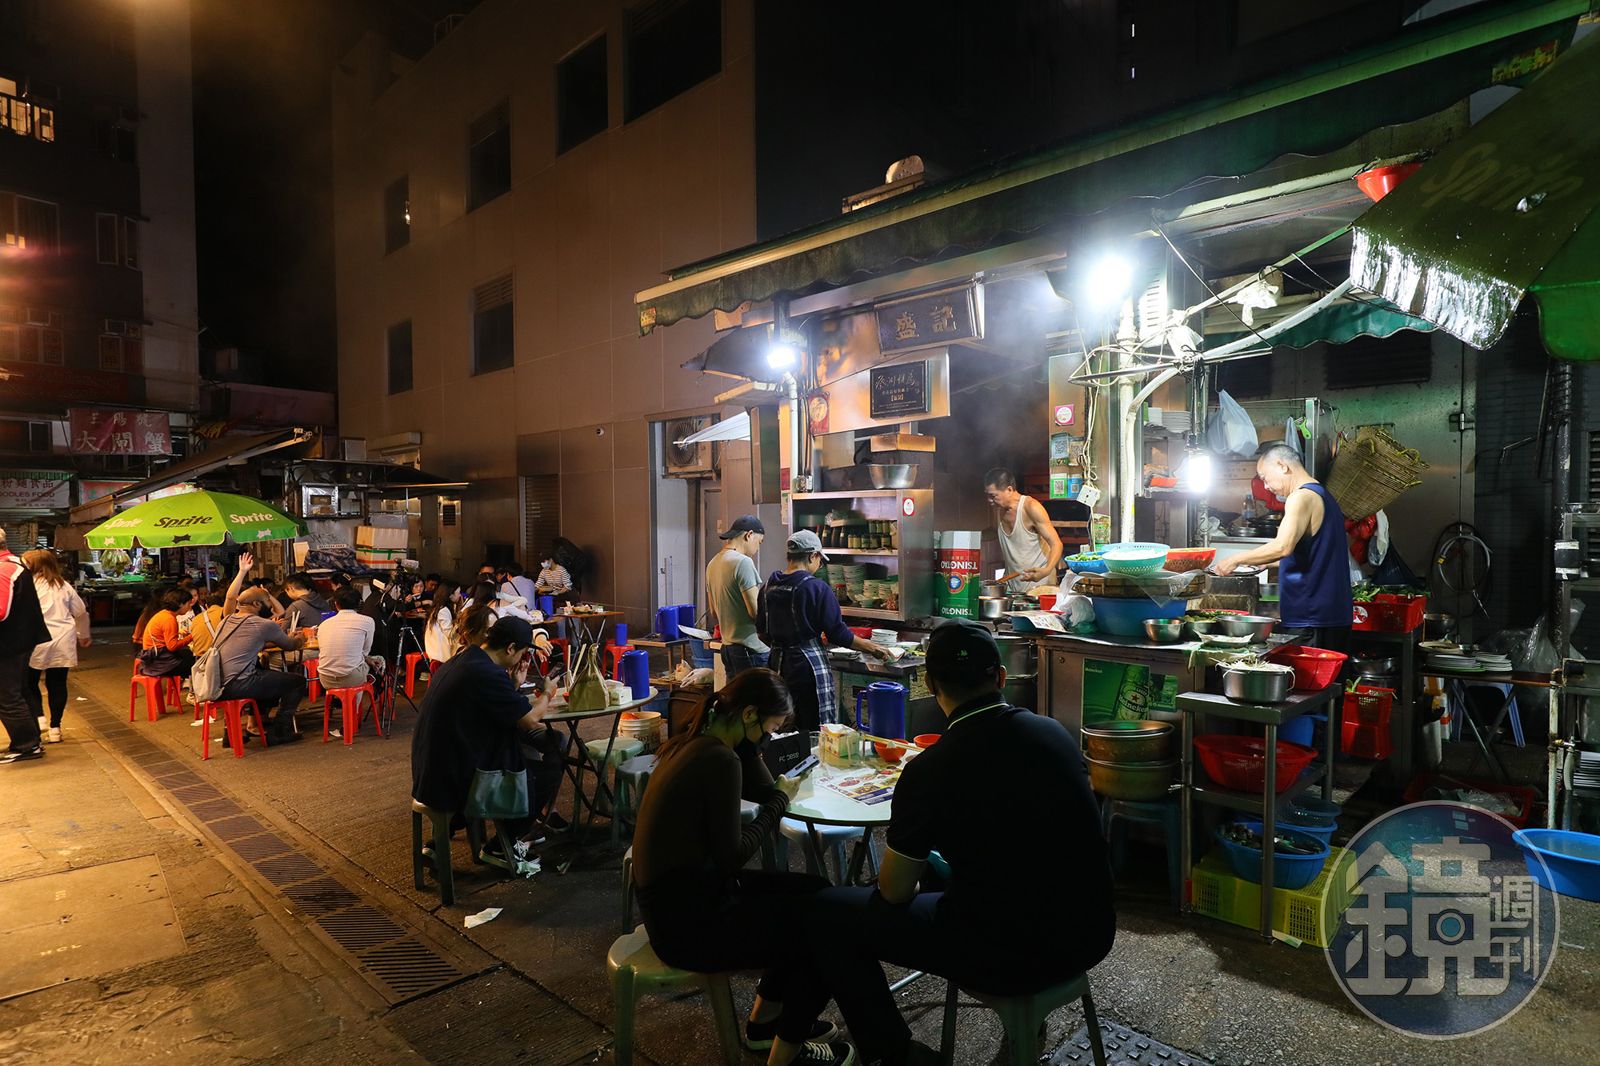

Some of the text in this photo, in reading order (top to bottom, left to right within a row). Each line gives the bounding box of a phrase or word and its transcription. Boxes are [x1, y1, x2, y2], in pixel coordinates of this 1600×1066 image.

[896, 304, 957, 341] 盛記
[77, 430, 165, 454] 大閘蟹
[154, 516, 213, 528] Sprite
[229, 513, 274, 524] Sprite
